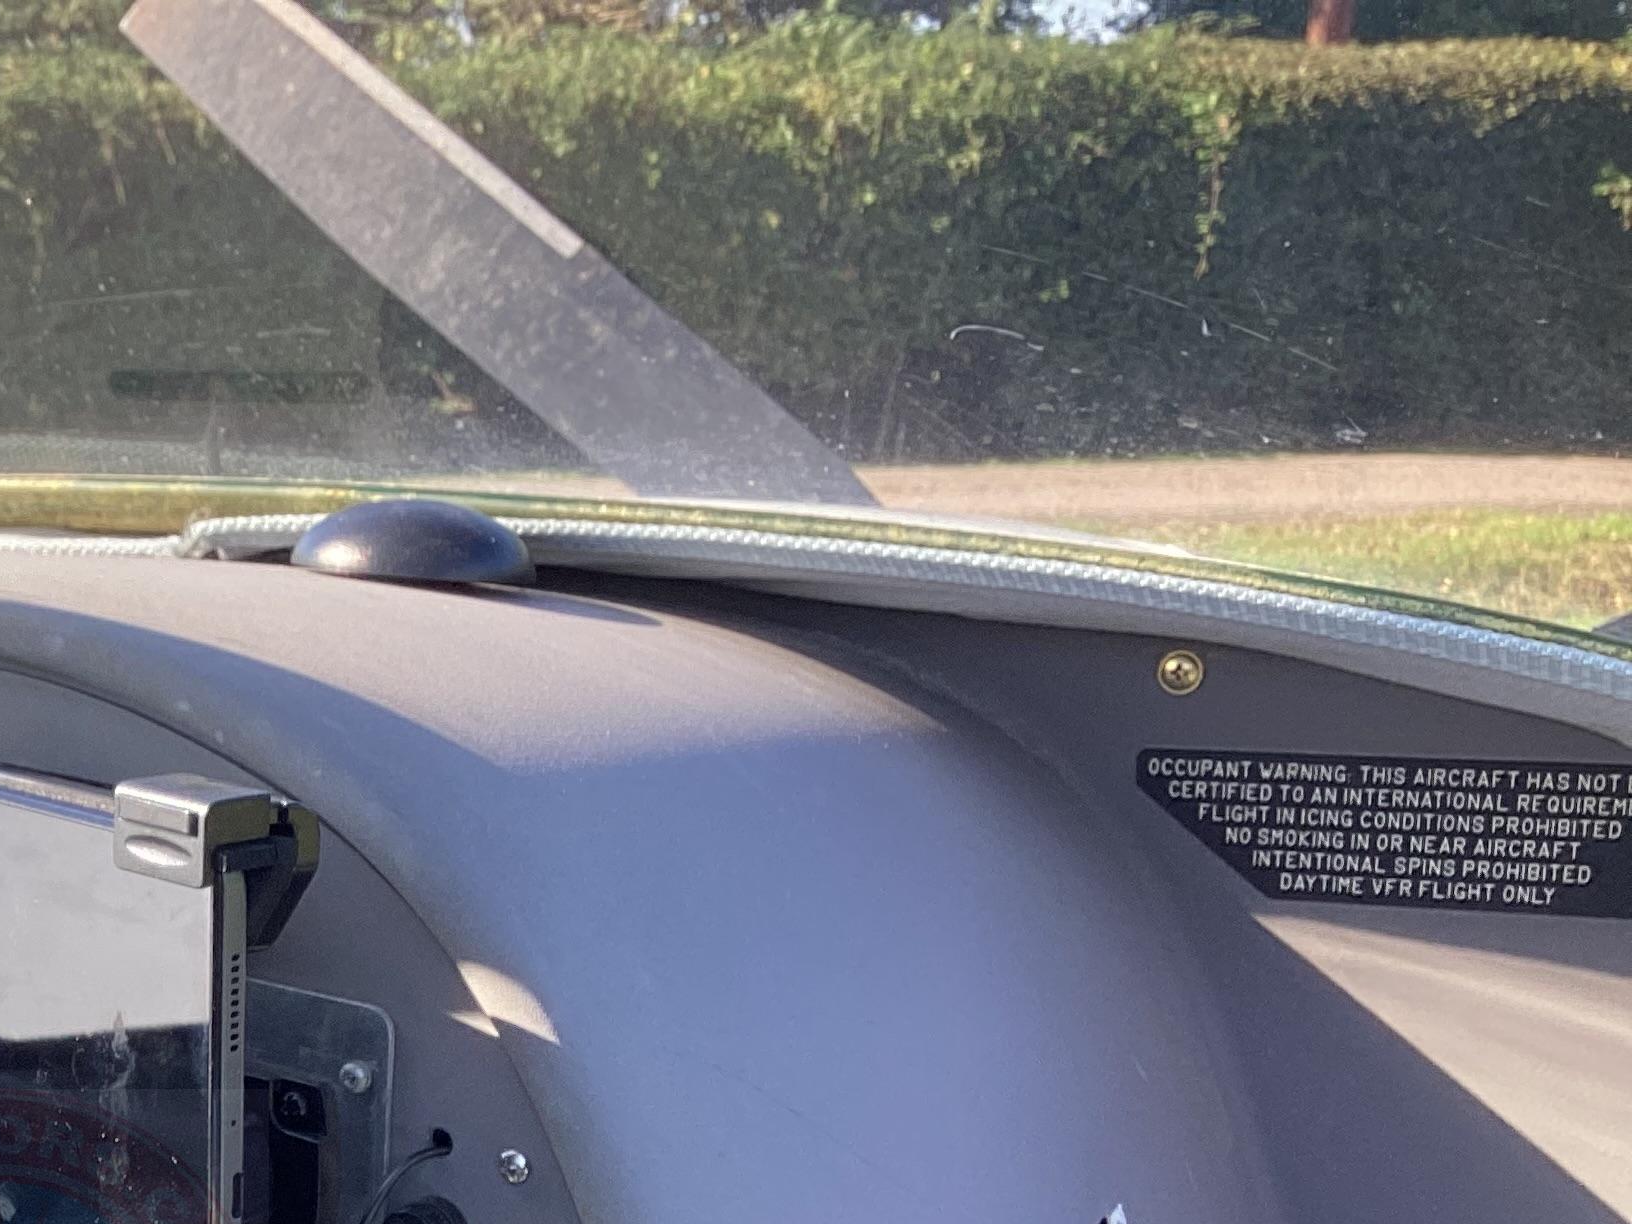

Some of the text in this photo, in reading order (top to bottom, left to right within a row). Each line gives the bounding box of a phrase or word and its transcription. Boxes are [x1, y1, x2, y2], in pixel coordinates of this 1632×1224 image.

[1148, 758, 1252, 779] OCCUPANT
[1360, 765, 1406, 785] THIS
[1413, 767, 1519, 790] AIRCRAFT
[1526, 772, 1570, 791] HAS
[1577, 774, 1621, 793] NOT
[1169, 780, 1272, 801] CERTIFIED
[1280, 784, 1304, 803] TO
[1311, 787, 1337, 805] AN
[1343, 788, 1508, 812] INTERNATIONAL
[1199, 803, 1622, 840] FLIGHT IN ICING CONDITIONS PROHIBITED
[1225, 827, 1581, 860] NO SMOKING IN OR NEAR AIRCRAFT
[1252, 850, 1591, 885] INTENTIONAL SPINS PROHIBITED
[1280, 872, 1555, 905] DAYTIME VFR FLIGHT ONLY
